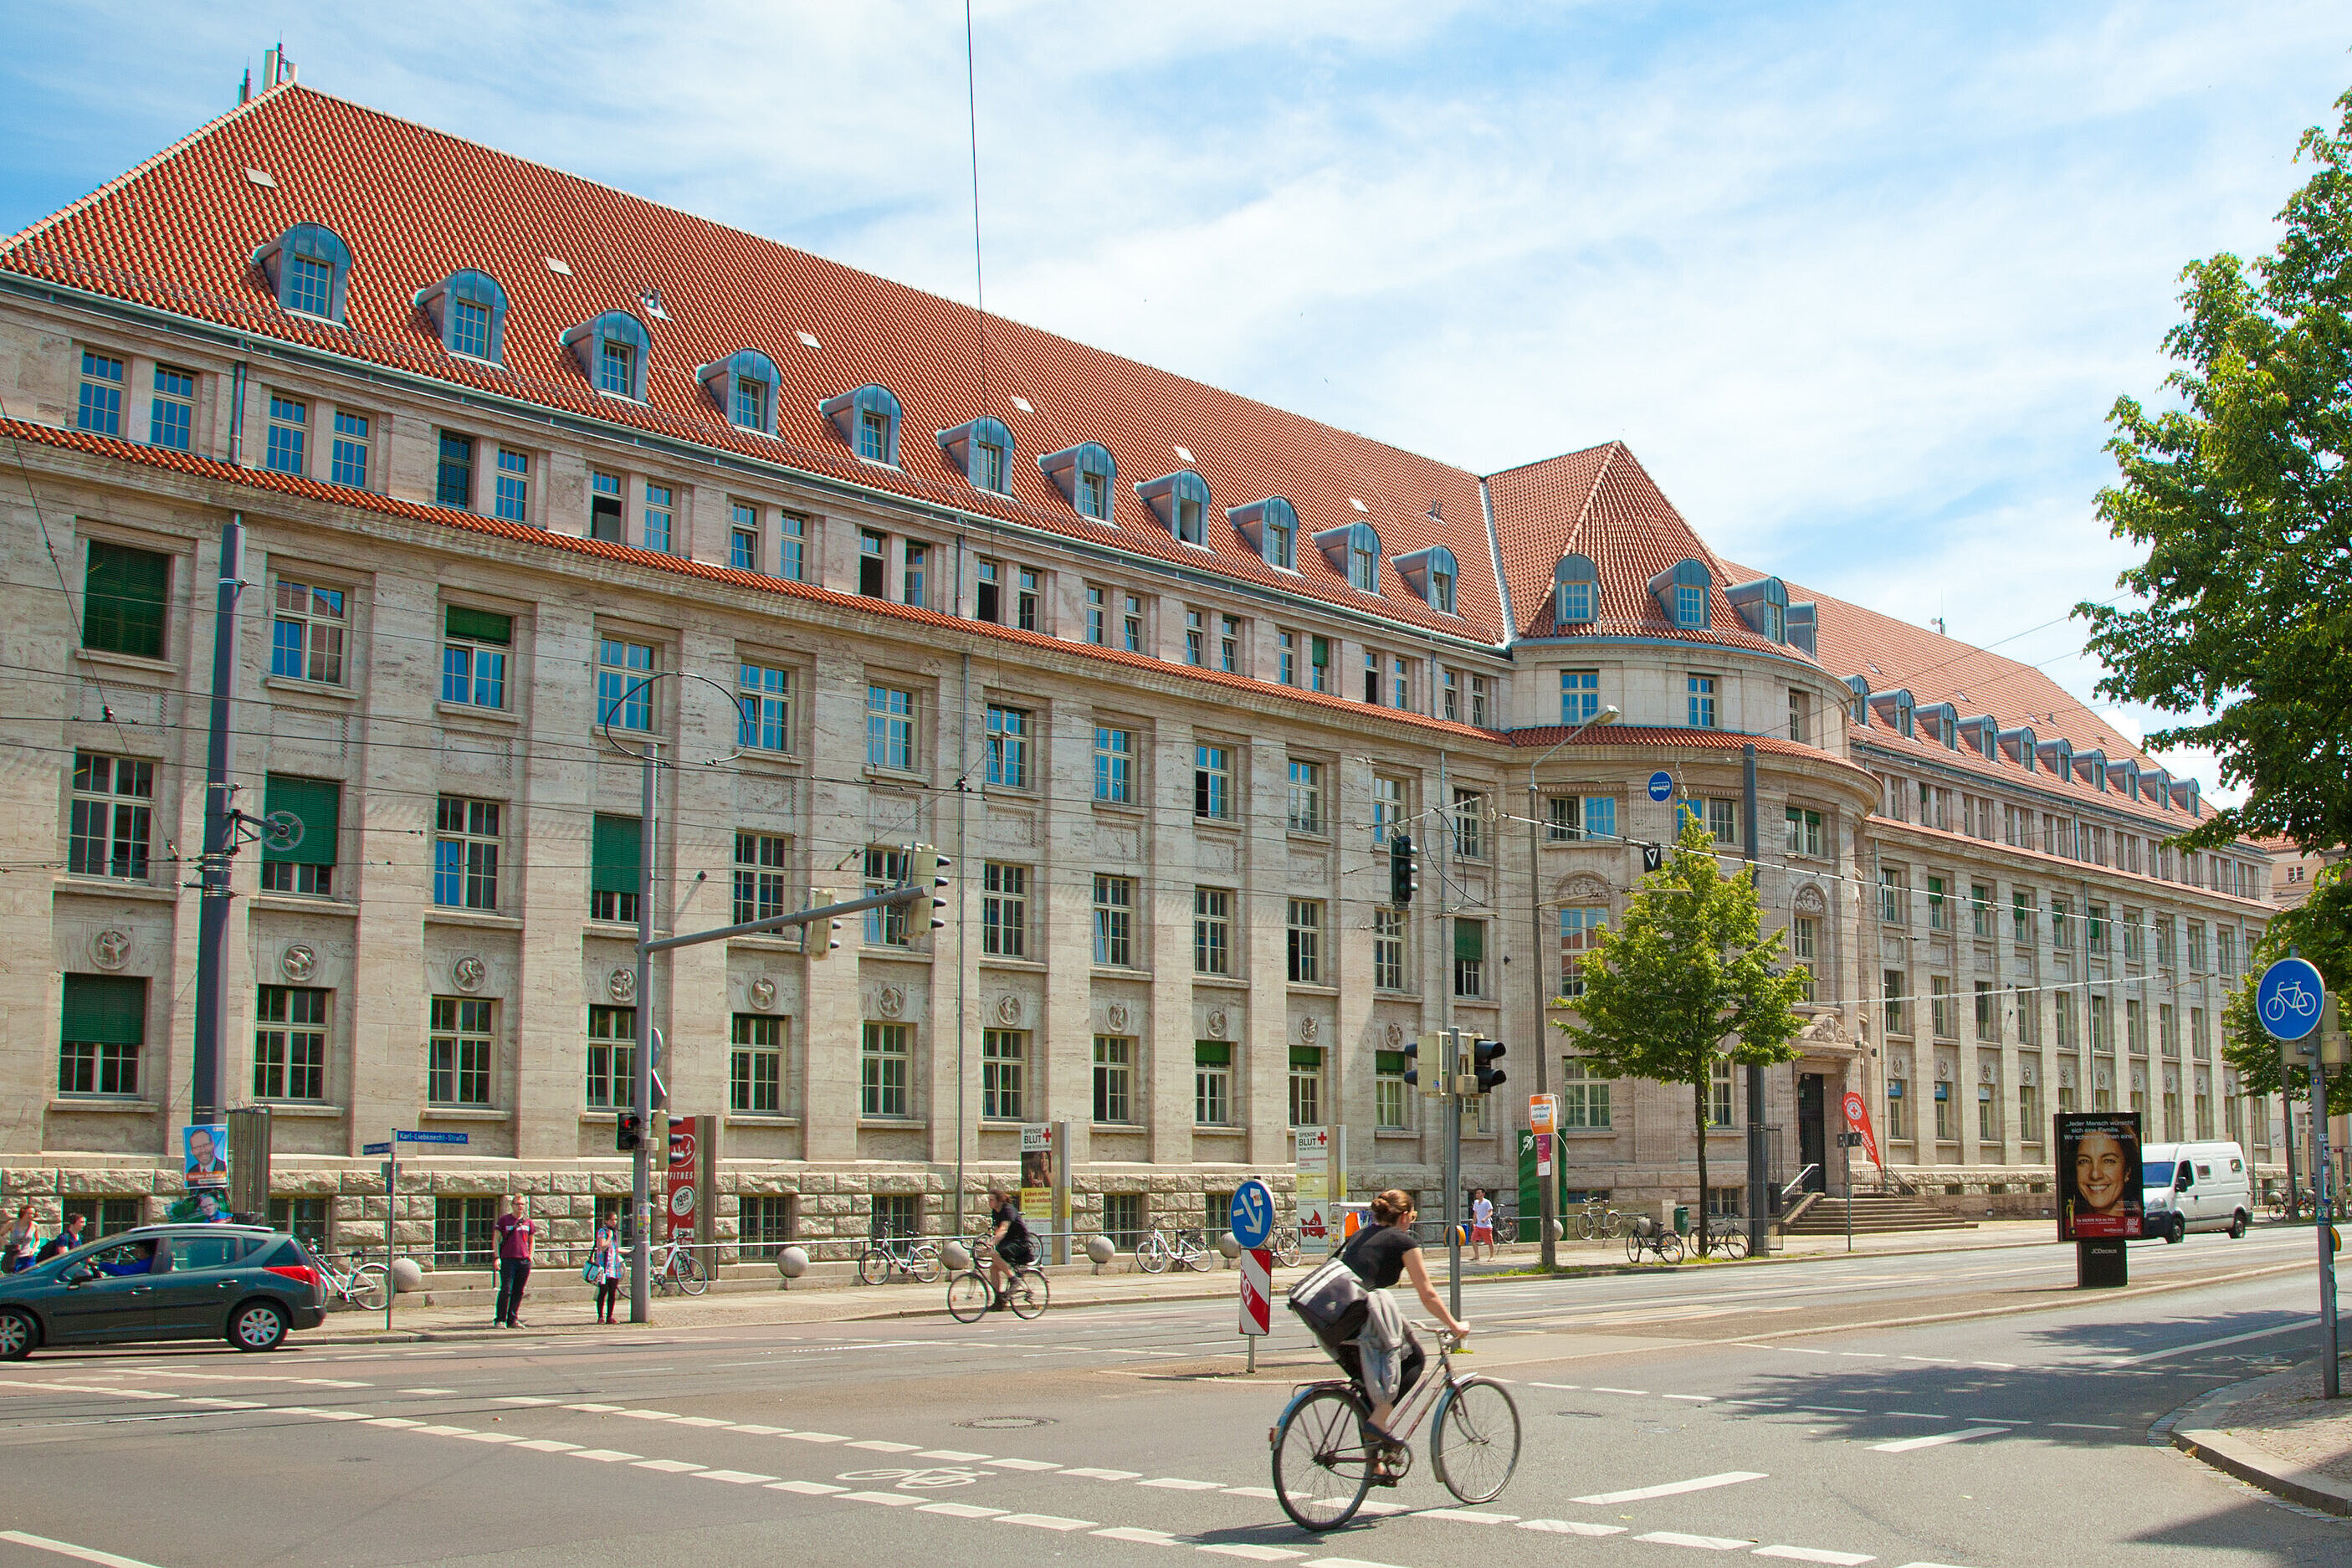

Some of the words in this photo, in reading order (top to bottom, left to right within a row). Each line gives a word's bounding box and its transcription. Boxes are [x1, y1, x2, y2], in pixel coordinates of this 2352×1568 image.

[399, 1132, 467, 1143] Karl-Liebknecht-Straße
[1024, 1135, 1042, 1144] BLUT
[1299, 1138, 1316, 1146] BLUT
